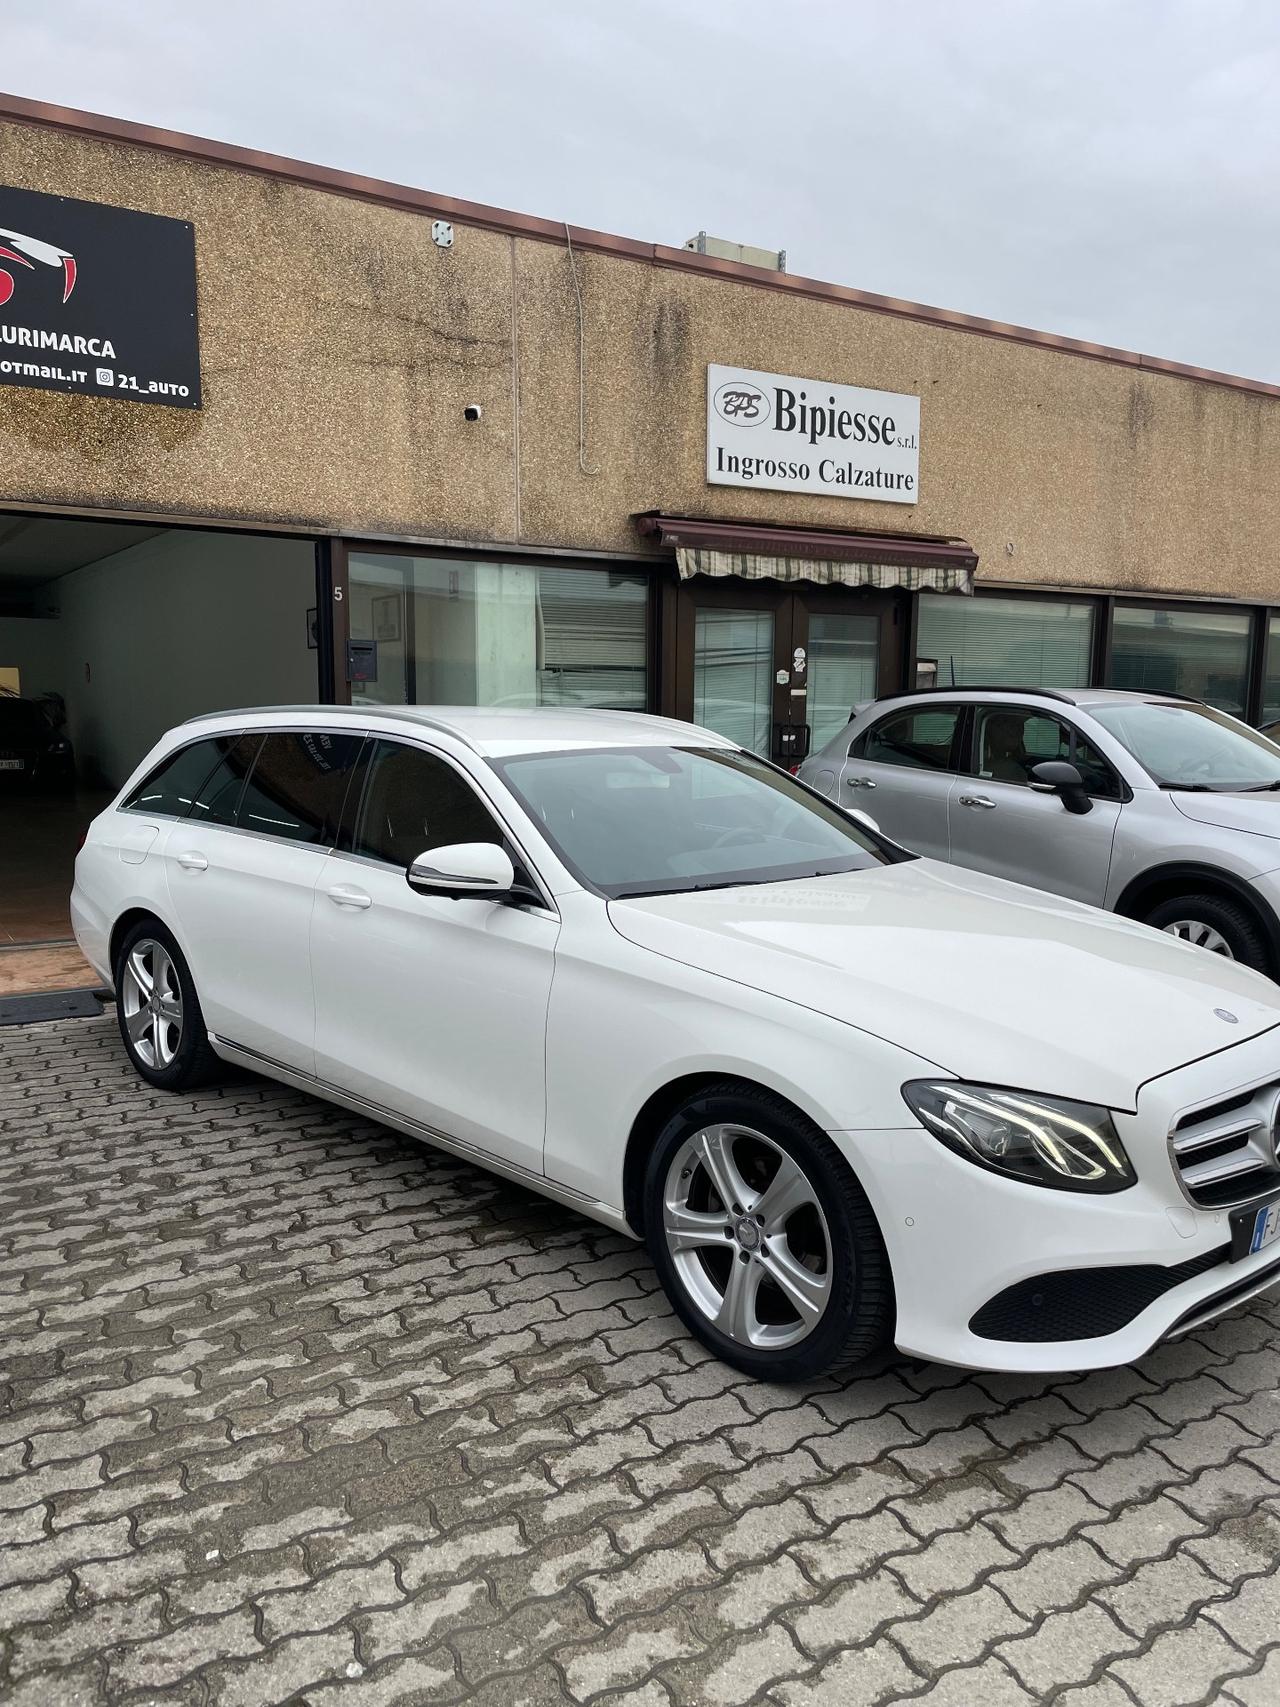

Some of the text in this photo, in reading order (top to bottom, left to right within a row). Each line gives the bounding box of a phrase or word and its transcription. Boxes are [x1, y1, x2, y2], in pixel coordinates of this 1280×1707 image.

[0, 325, 116, 359] URIMARCA
[772, 387, 917, 449] Bipiesse s.r.l.
[716, 447, 914, 490] Ingrosso Calzature
[334, 586, 343, 601] 5
